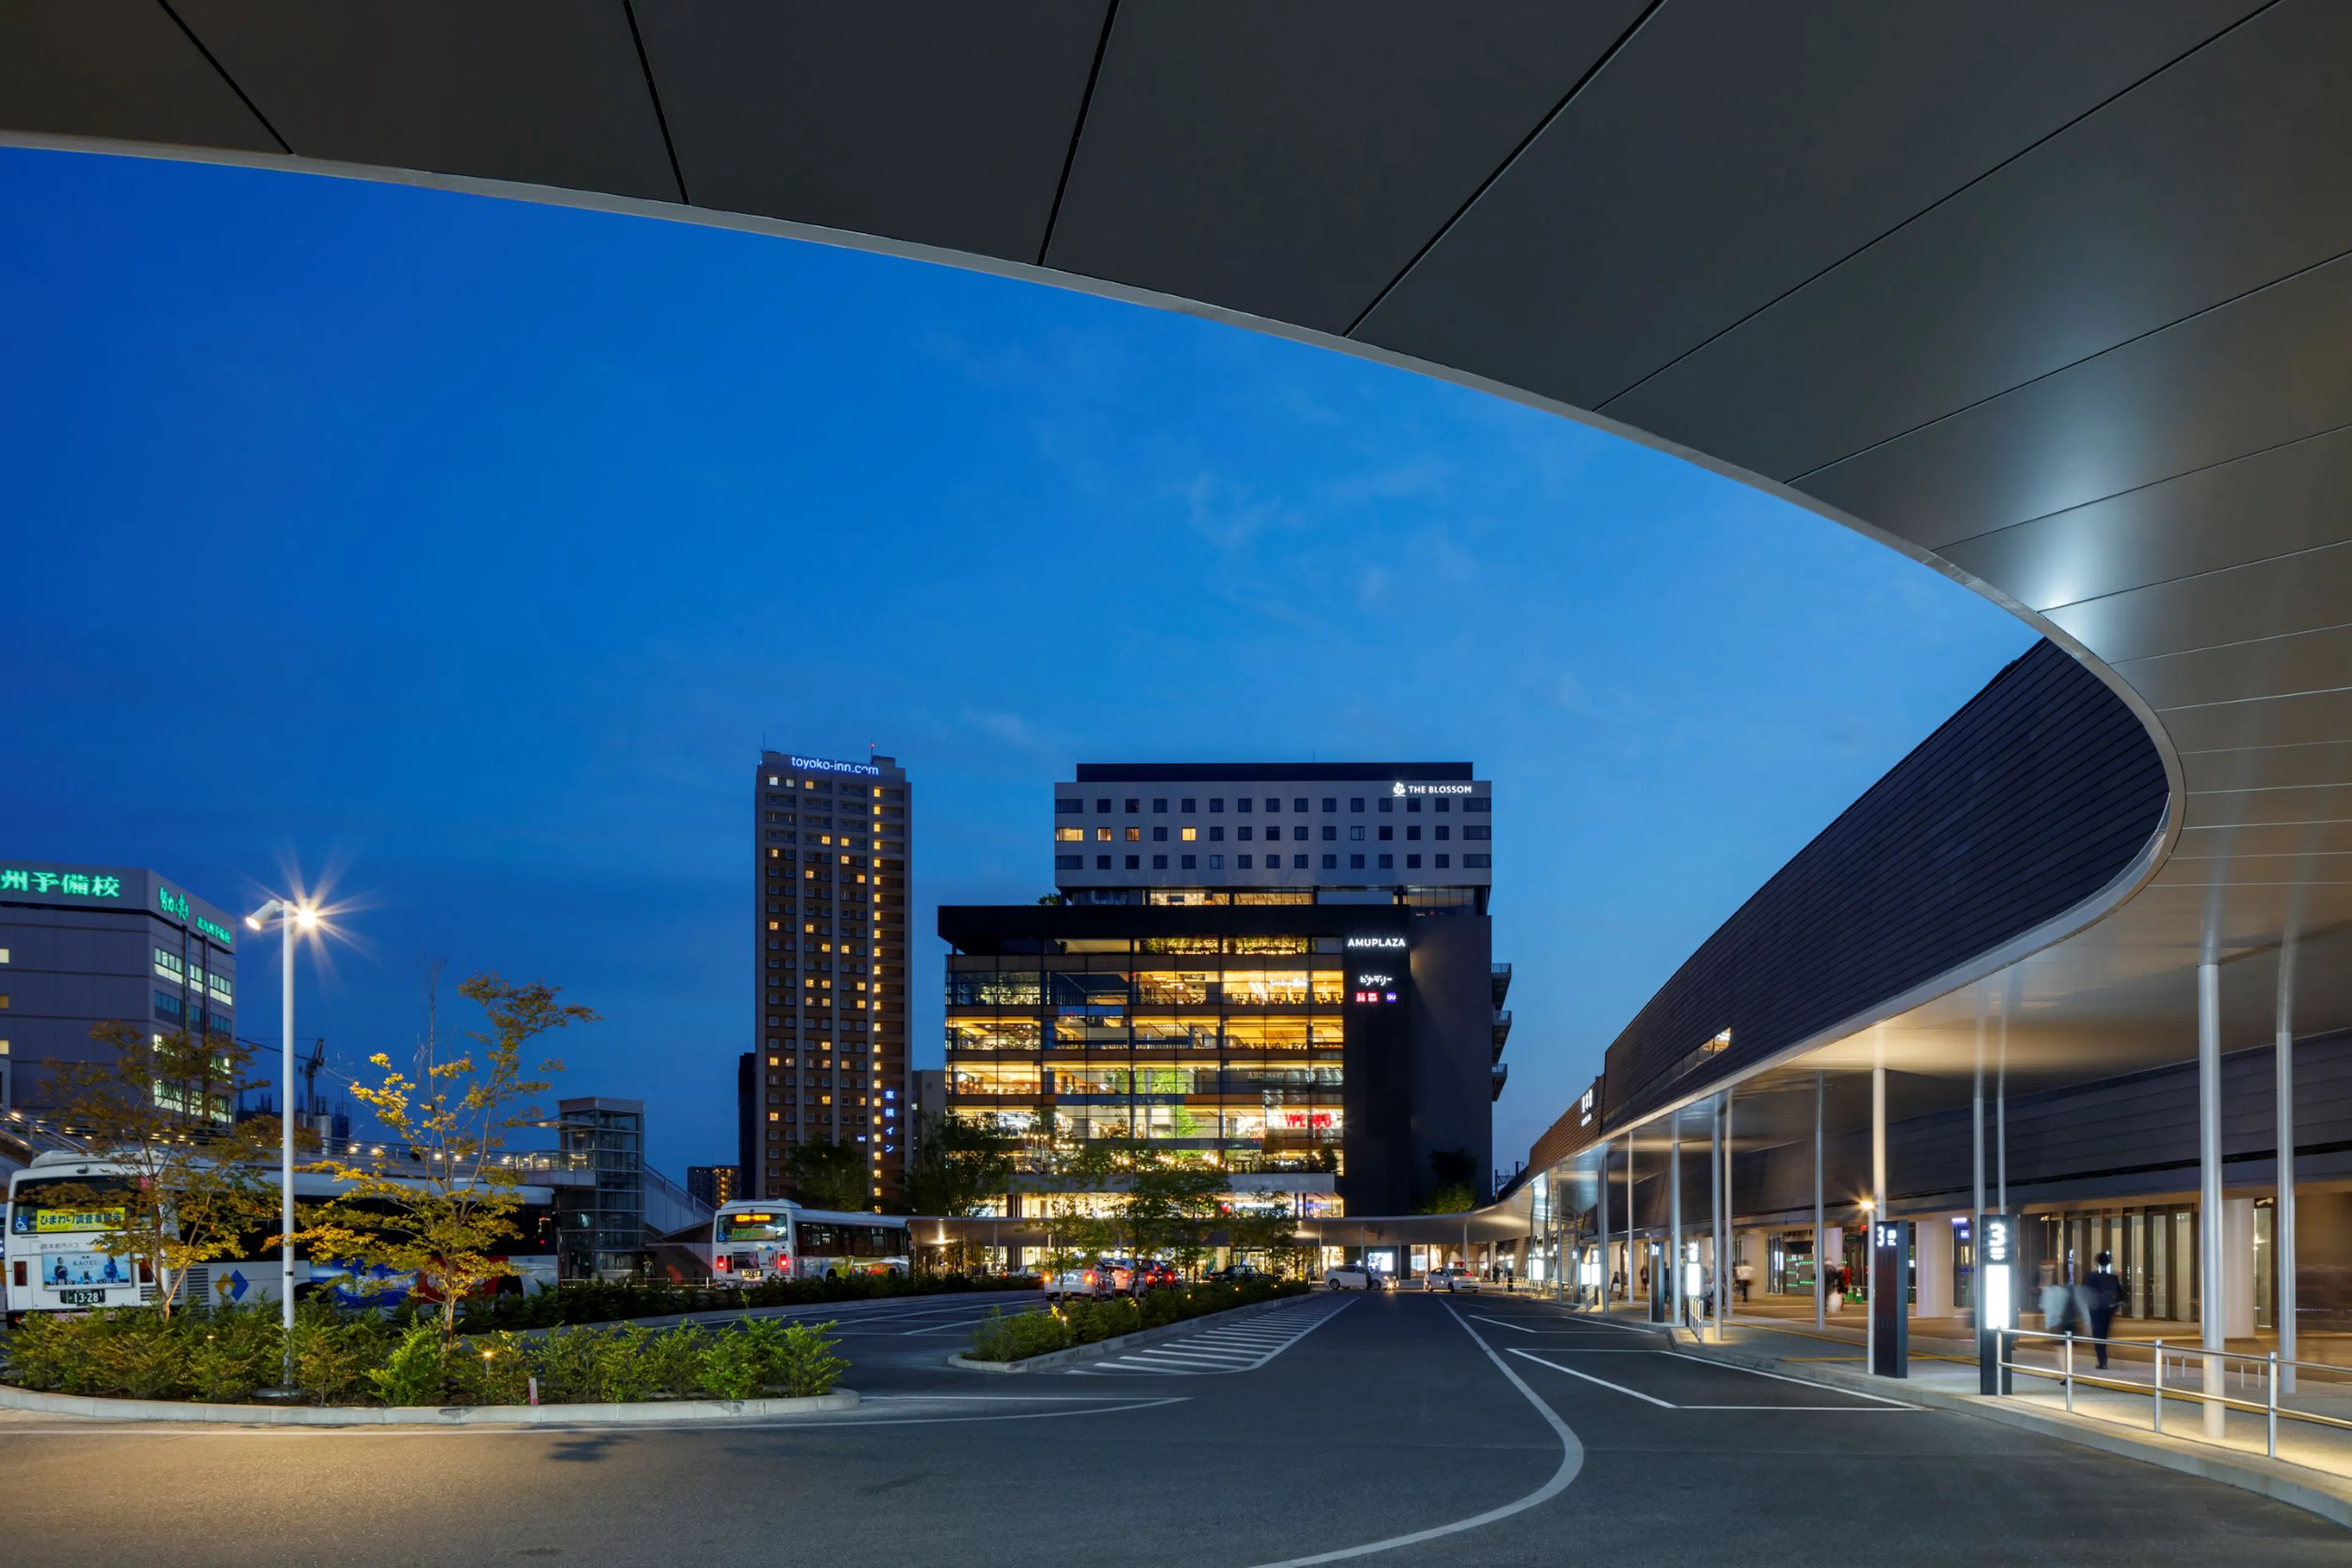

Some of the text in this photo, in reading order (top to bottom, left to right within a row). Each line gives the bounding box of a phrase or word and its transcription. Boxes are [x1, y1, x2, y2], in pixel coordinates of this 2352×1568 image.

[791, 756, 879, 775] toyoko-inn.com
[1348, 938, 1406, 947] AMUPLAZA
[1877, 1225, 1885, 1247] 3
[1989, 1223, 2005, 1247] 3
[74, 1292, 99, 1303] 13-28
